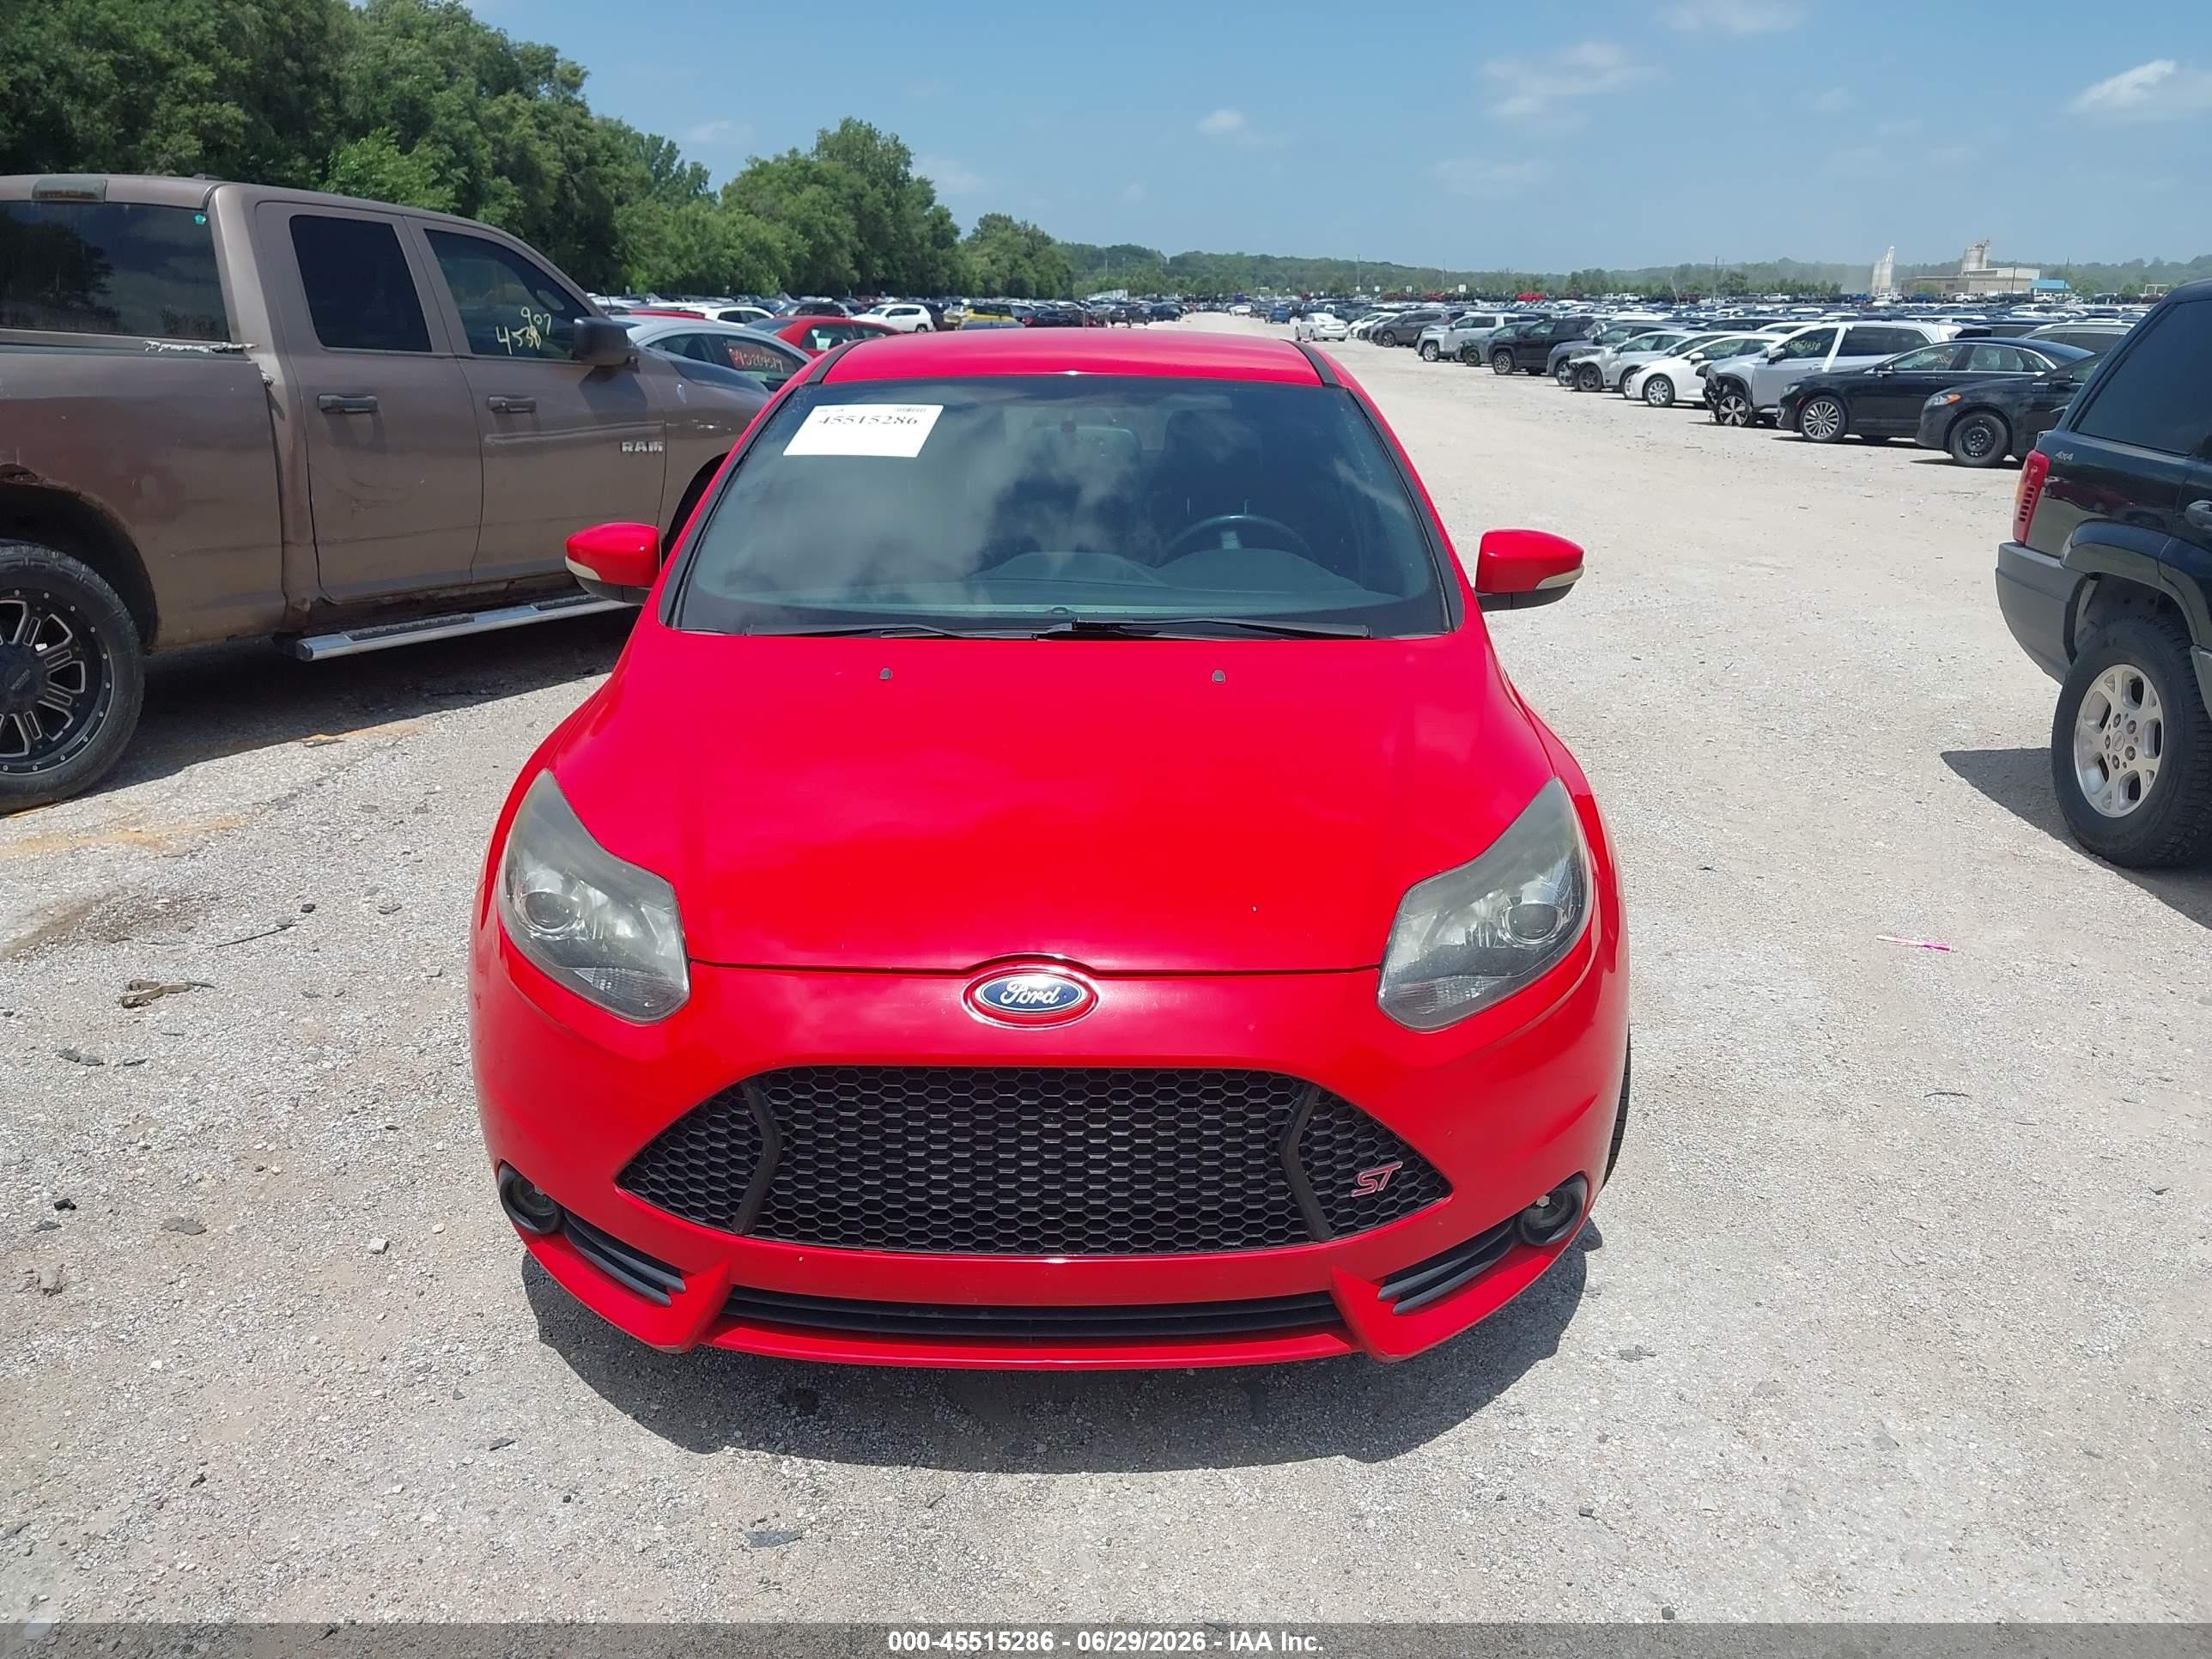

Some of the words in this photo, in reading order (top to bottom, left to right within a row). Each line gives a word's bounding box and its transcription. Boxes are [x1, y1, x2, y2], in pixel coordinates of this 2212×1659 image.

[818, 415, 919, 425] 45515286
[622, 441, 663, 453] RAM
[1000, 980, 1061, 1005] Ford
[1351, 1161, 1403, 1198] ST
